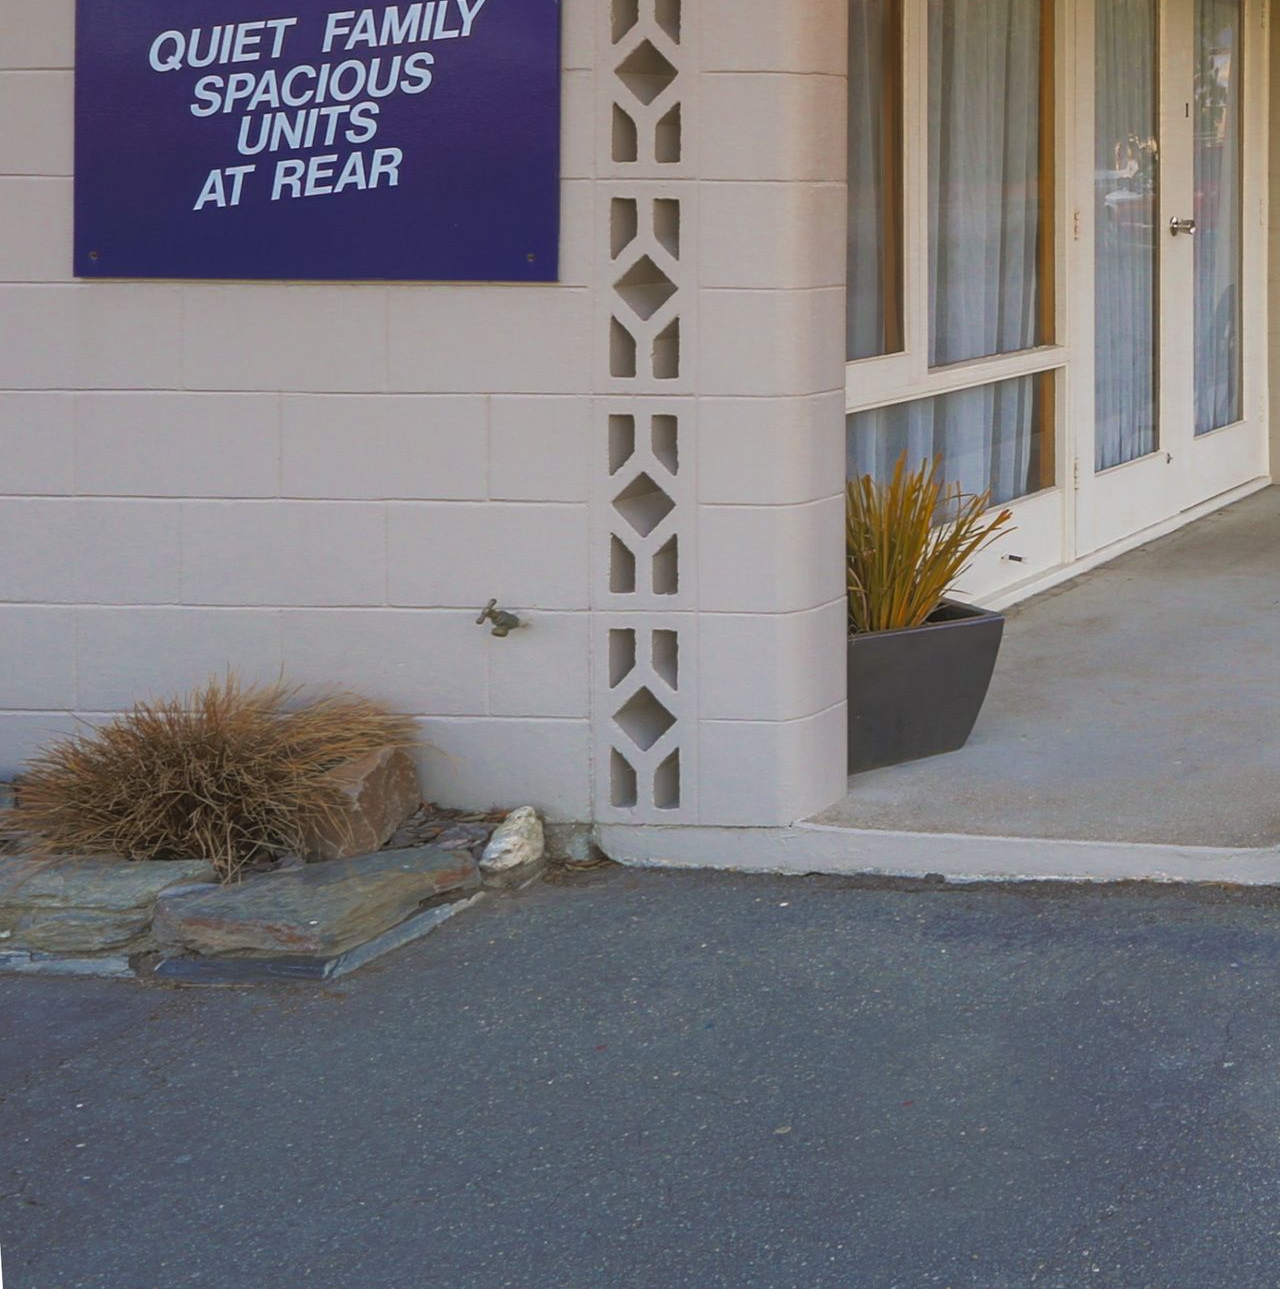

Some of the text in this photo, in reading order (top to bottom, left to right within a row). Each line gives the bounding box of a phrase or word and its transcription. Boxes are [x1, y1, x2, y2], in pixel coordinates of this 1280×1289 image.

[148, 17, 297, 72] QUIET
[190, 52, 434, 117] SPACIOUS
[236, 101, 381, 156] UNITS
[192, 147, 403, 211] AT REAR
